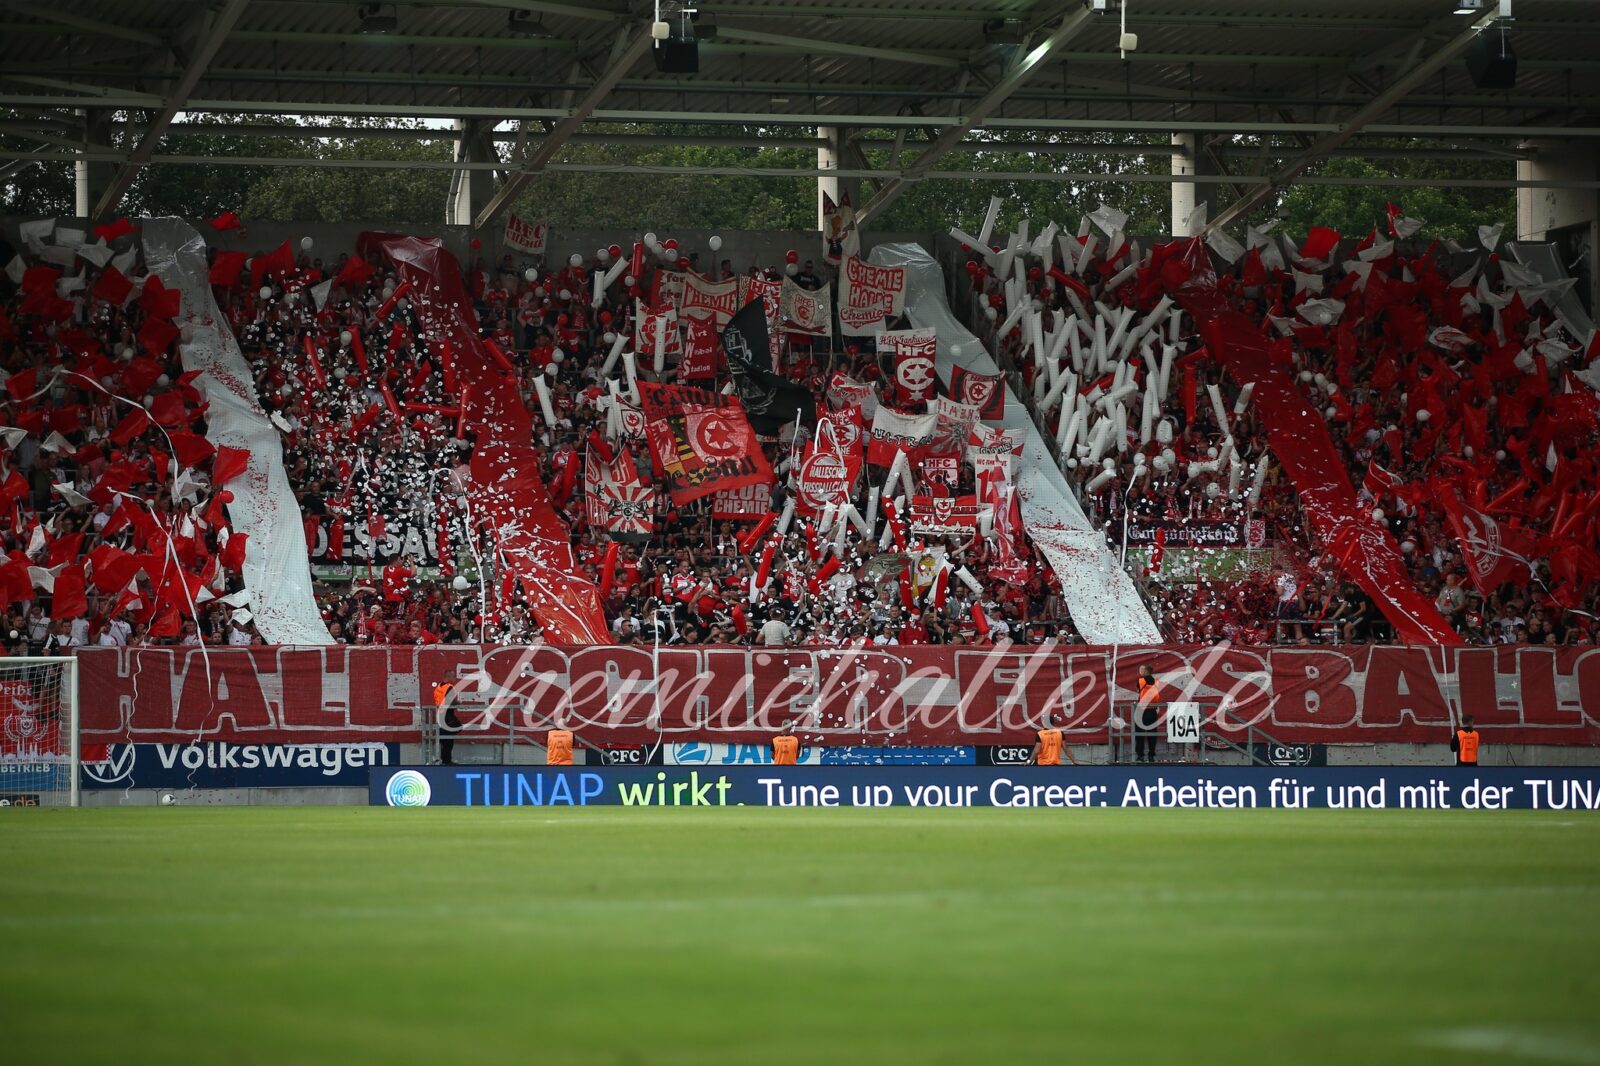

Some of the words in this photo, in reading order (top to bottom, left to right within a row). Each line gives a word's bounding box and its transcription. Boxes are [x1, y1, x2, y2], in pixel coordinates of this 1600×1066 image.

[847, 260, 903, 292] CHEMIE
[682, 283, 738, 316] CHEMIE
[898, 344, 936, 357] HFC
[928, 459, 951, 468] HFC
[714, 500, 768, 514] CHEMIE
[1170, 713, 1198, 738] 19A
[609, 750, 640, 763] CFC
[998, 747, 1029, 761] CFC
[455, 773, 604, 806] TUNAP
[758, 778, 840, 806] Tune
[989, 778, 1107, 807] Career:
[1121, 777, 1257, 807] Arbeiten
[1268, 778, 1316, 808] für
[1326, 778, 1386, 808] und
[1399, 779, 1450, 808] mit
[1461, 778, 1514, 809] der
[1523, 779, 1600, 809] TUN
